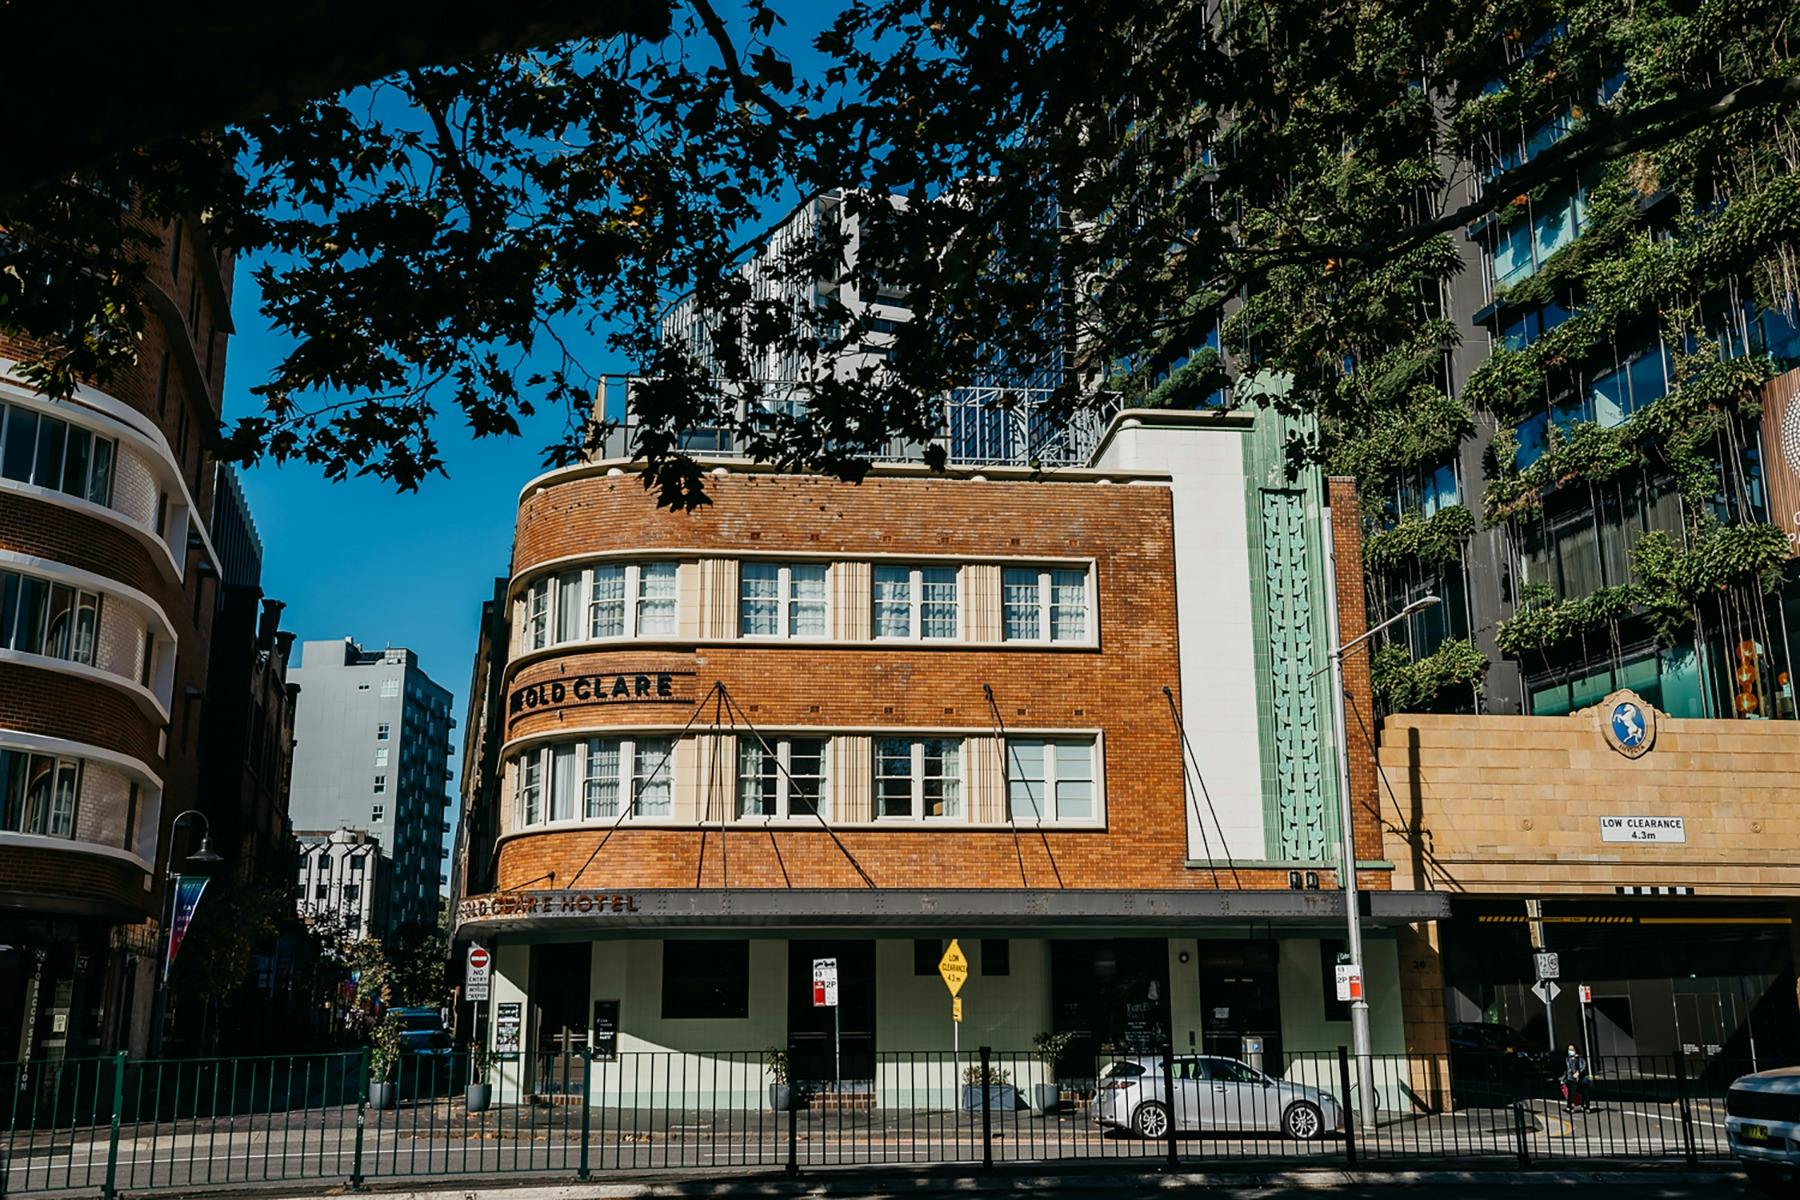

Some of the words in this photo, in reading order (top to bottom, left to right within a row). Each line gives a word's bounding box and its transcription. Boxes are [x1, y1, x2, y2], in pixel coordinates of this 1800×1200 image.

[526, 683, 565, 708] OLD
[573, 674, 672, 699] CLARE
[1602, 819, 1623, 827] LOW
[1627, 819, 1682, 828] CLEARANCE
[1631, 831, 1656, 839] 4.3m
[491, 896, 552, 915] CLARE
[560, 895, 638, 913] HOTEL
[948, 954, 959, 962] LOW
[942, 963, 965, 972] CLEARANCE
[29, 963, 43, 1024] TOBACCO
[20, 1028, 34, 1091] STATION
